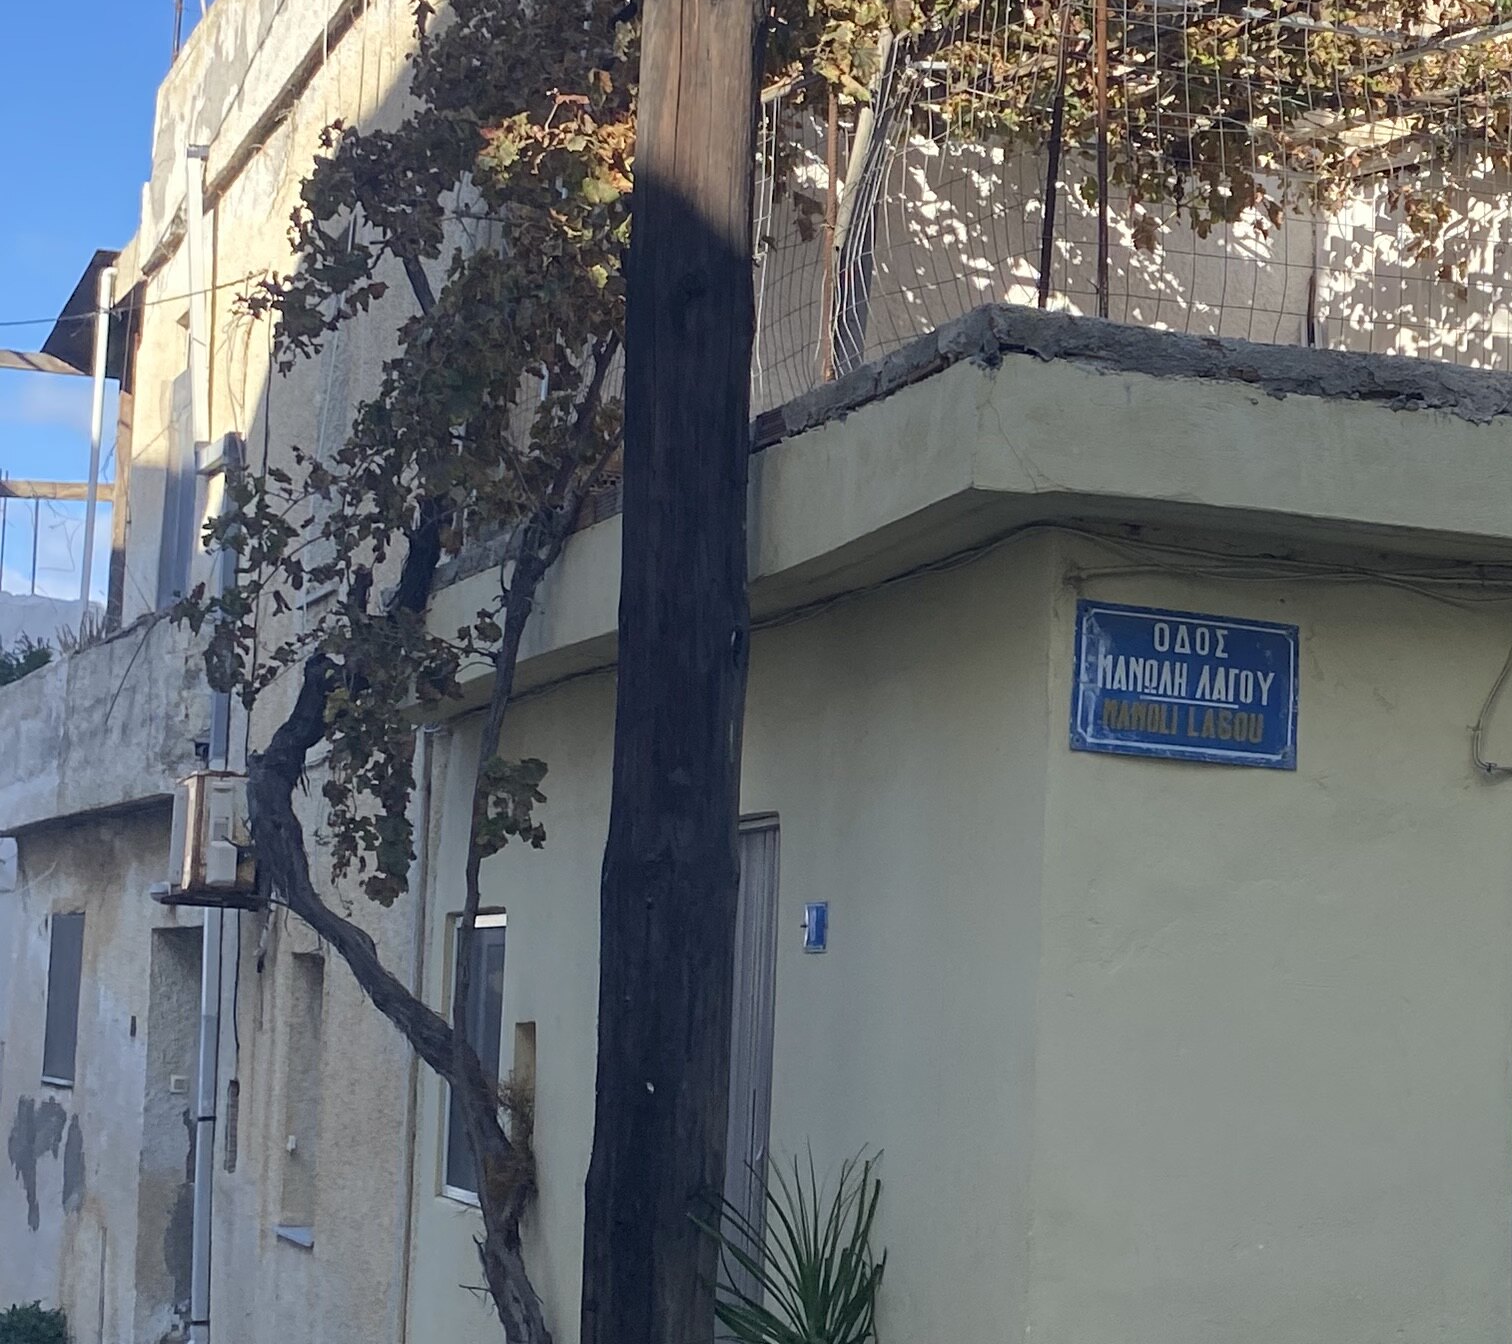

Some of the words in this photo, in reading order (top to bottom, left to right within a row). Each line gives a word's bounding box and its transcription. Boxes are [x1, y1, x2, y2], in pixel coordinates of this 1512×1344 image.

[1153, 622, 1228, 658] ΟΔΟΣ
[1097, 654, 1187, 697] ΜΑΝΩΛΗ
[1195, 664, 1276, 706] ΛΑΓΟΥ
[1103, 698, 1178, 735] MANOLI
